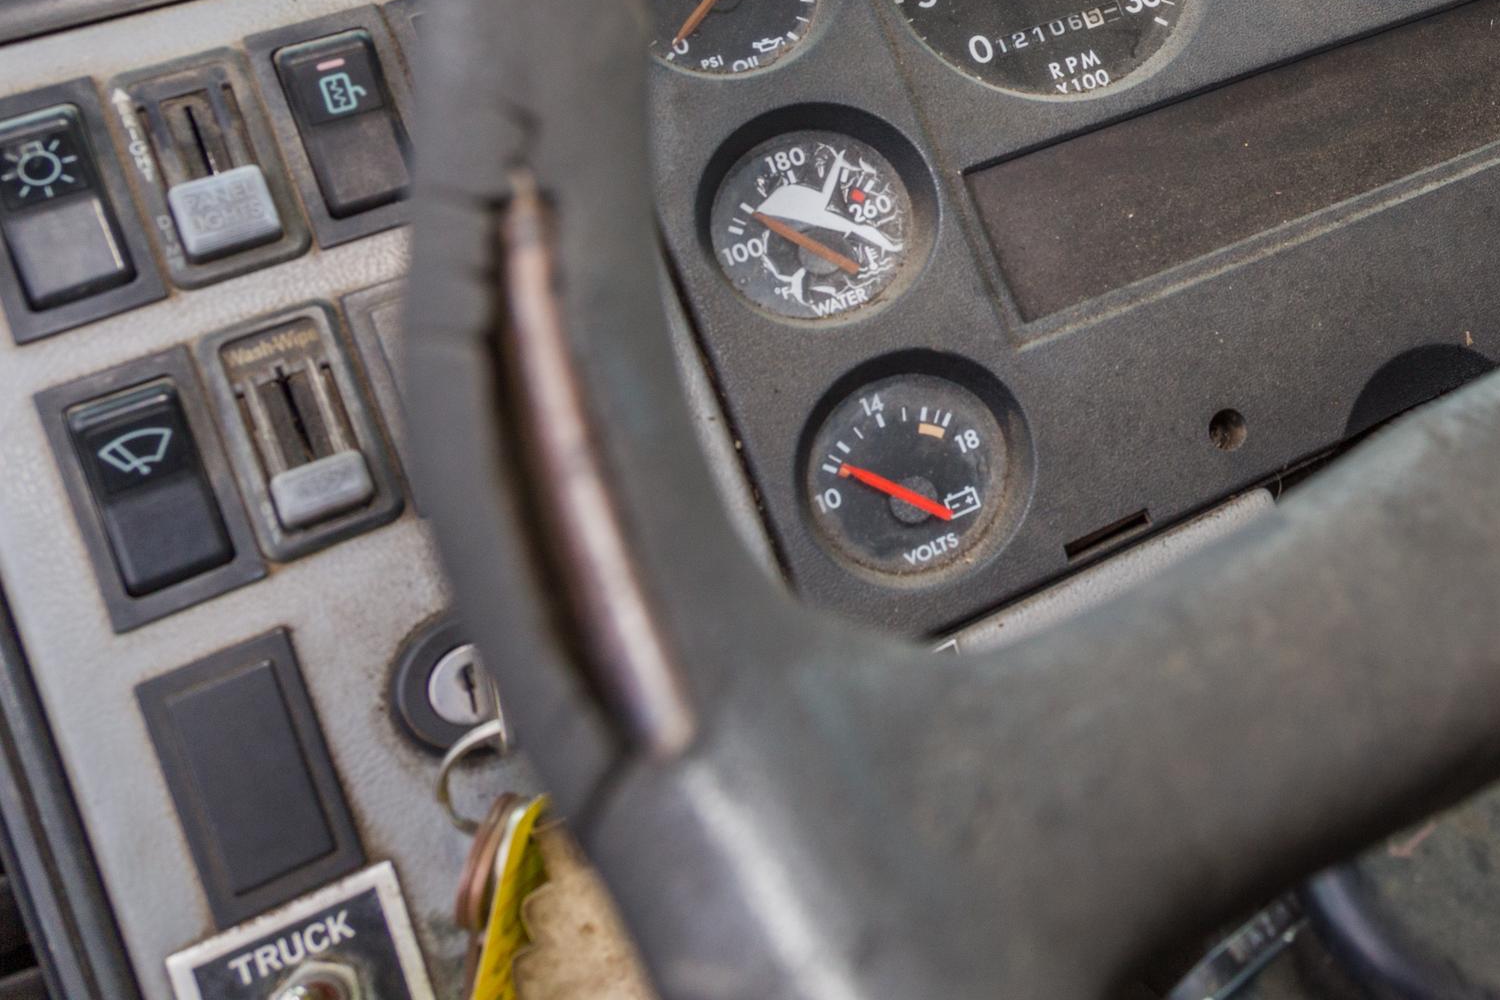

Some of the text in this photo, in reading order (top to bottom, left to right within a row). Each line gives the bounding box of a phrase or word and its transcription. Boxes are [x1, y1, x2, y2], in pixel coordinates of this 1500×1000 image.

[701, 55, 724, 69] PSI
[968, 35, 993, 63] 0
[1048, 49, 1101, 80] RPM
[765, 147, 805, 174] 180
[849, 194, 891, 222] 260
[723, 238, 762, 266] 100
[811, 288, 868, 316] WATER
[859, 393, 885, 416] 14
[954, 429, 980, 453] 18
[815, 488, 841, 513] 10
[904, 532, 959, 565] VOLTS
[228, 909, 357, 986] TRUCK
